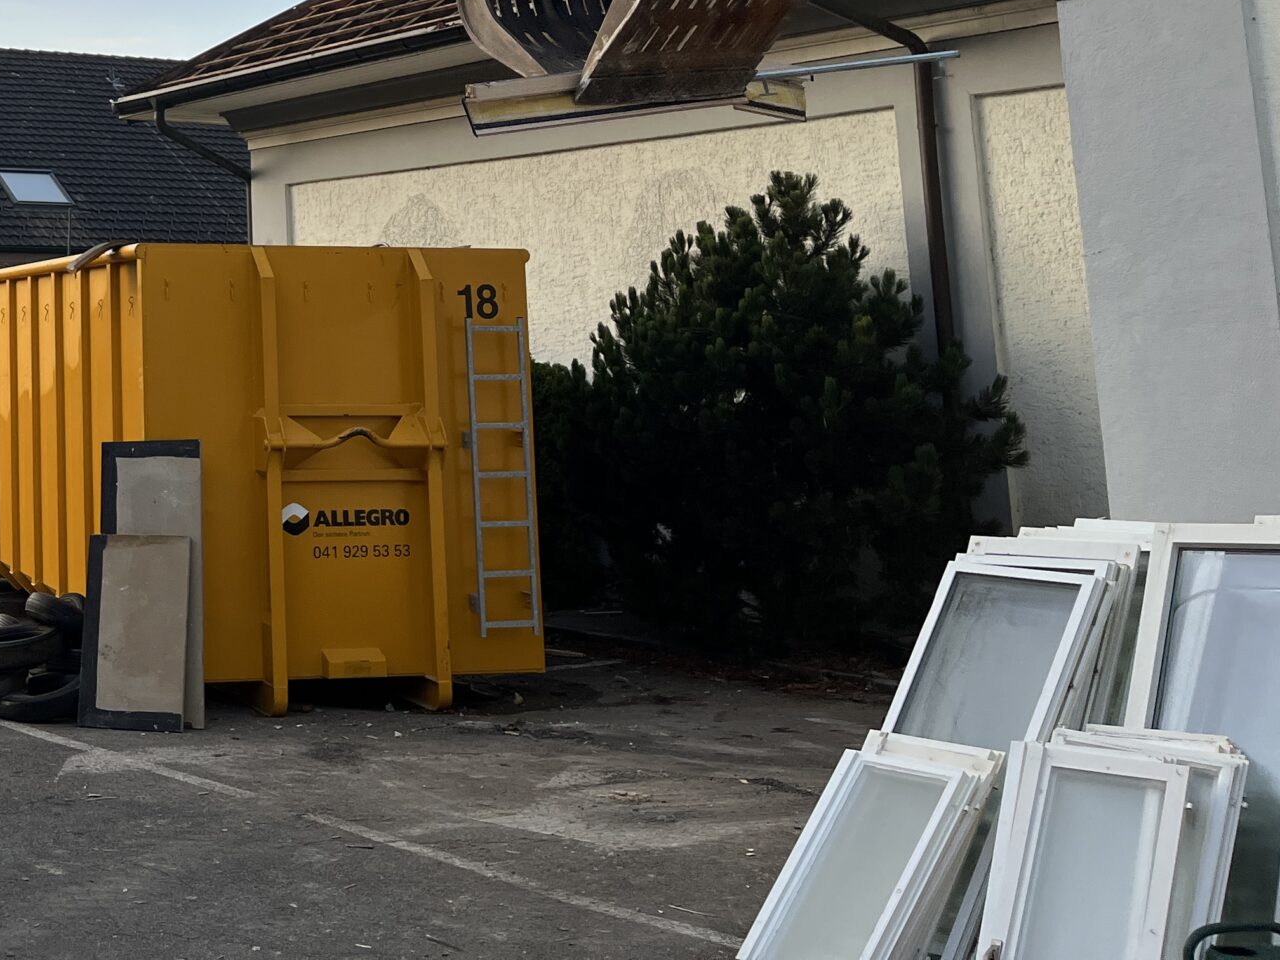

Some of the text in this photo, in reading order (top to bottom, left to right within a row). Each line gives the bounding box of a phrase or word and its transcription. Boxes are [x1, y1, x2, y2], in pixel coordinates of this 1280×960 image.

[457, 284, 499, 319] 18
[313, 508, 411, 527] ALLEGRO
[313, 544, 411, 559] 041 929 53 53
